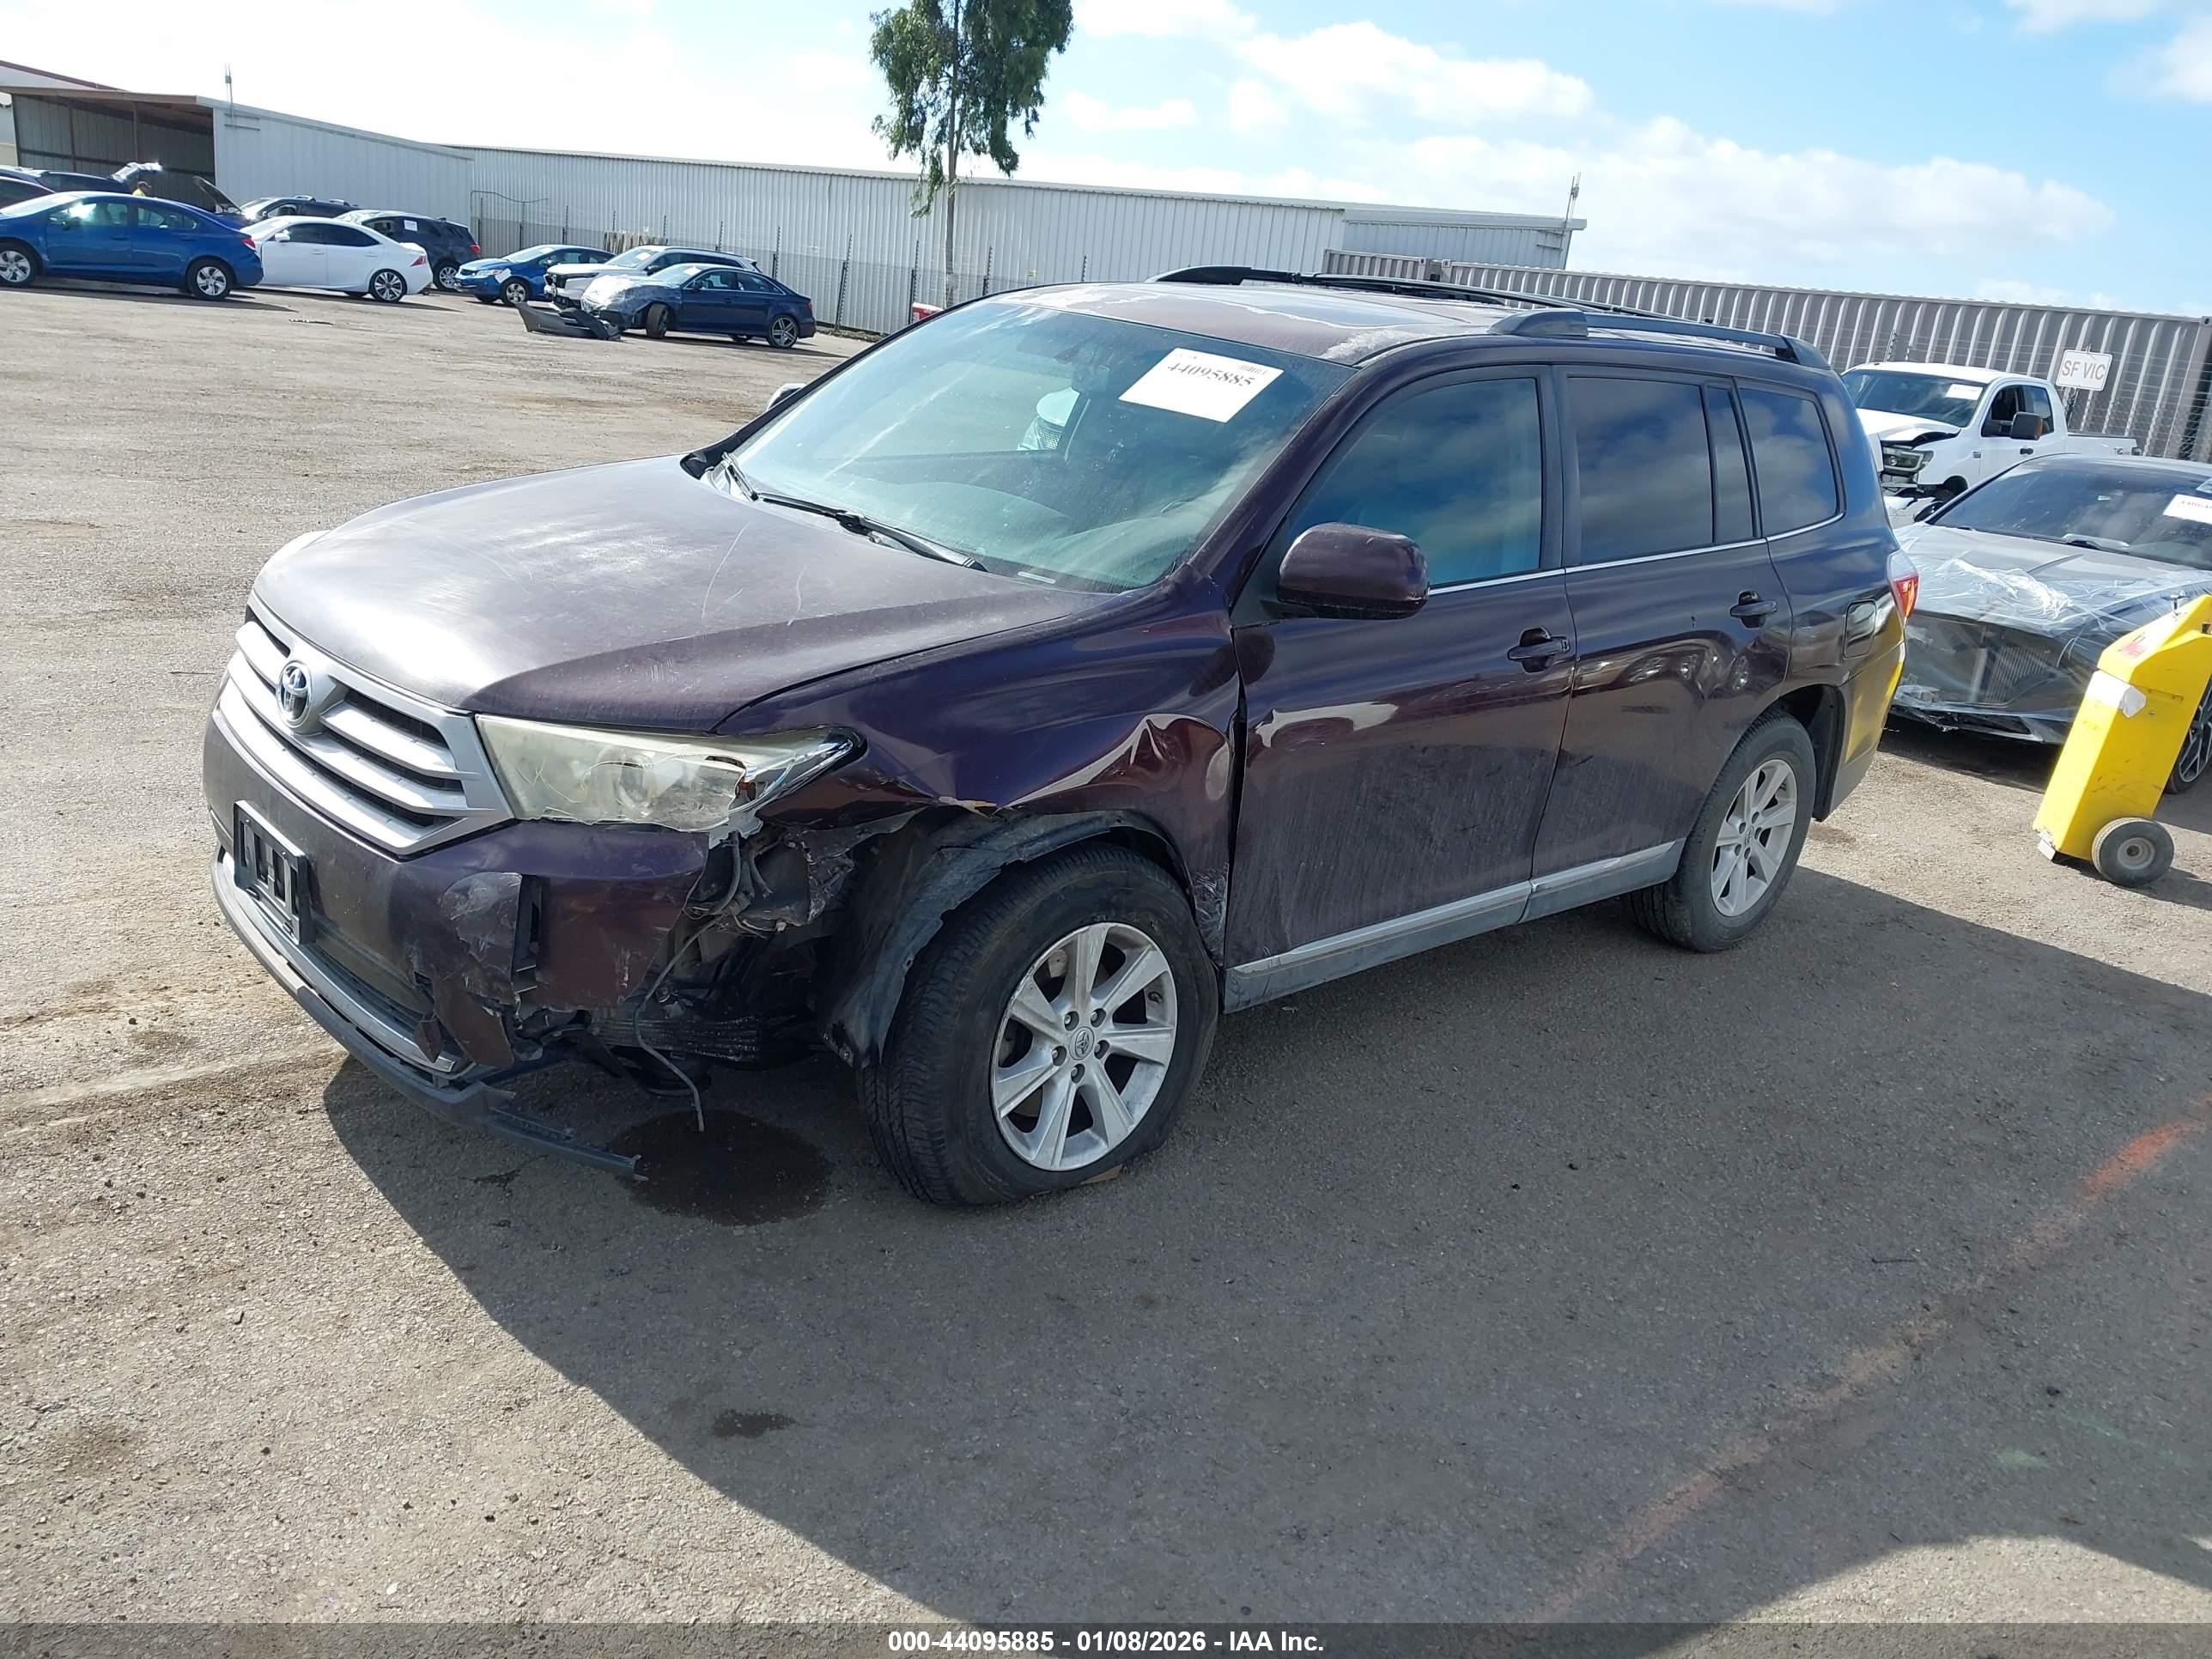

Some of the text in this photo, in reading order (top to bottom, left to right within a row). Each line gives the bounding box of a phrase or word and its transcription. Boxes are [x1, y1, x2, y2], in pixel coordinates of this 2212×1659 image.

[1167, 362, 1256, 386] 44095885
[2062, 360, 2106, 380] SF VIC
